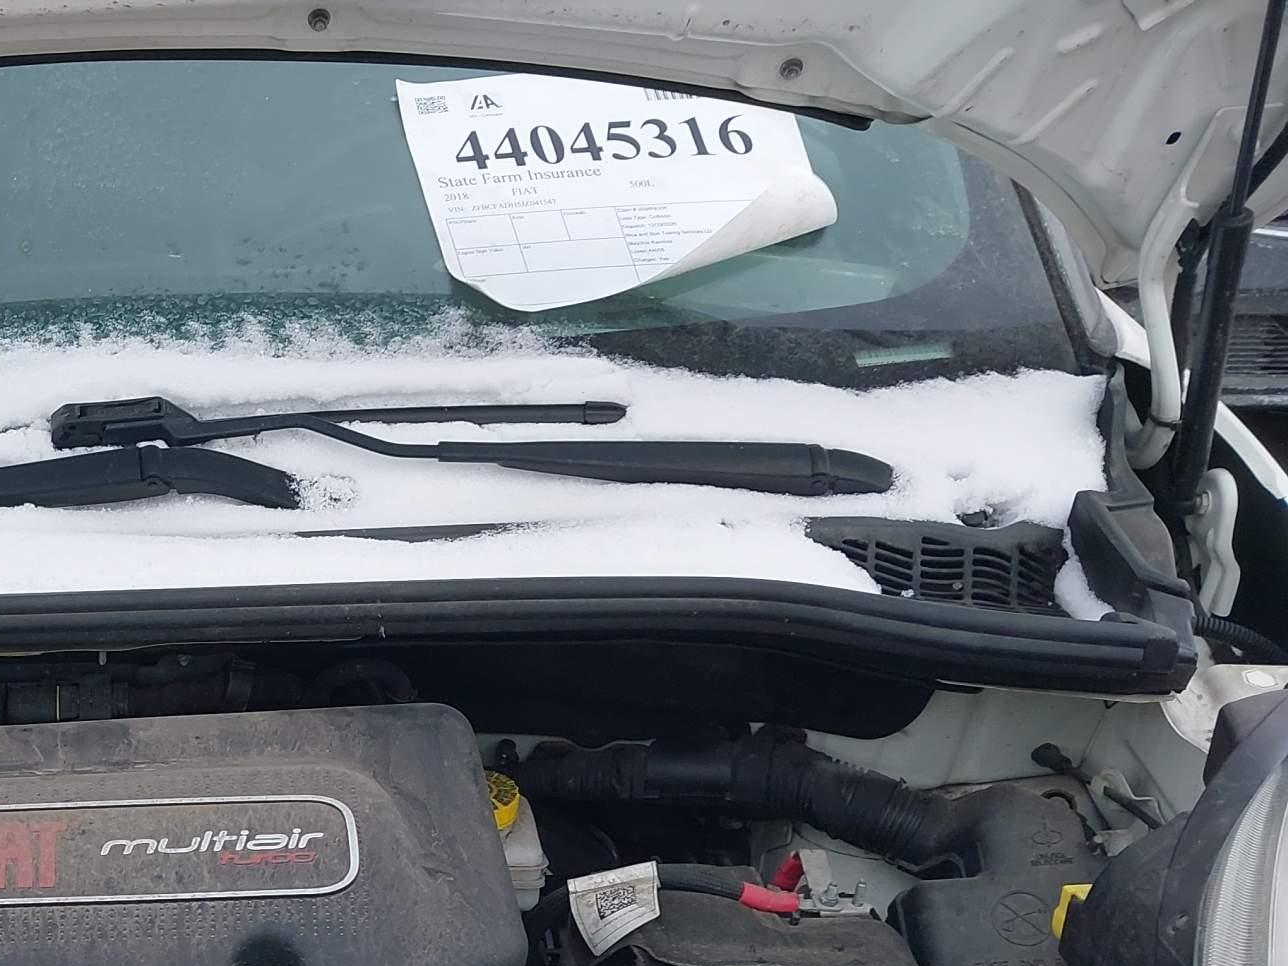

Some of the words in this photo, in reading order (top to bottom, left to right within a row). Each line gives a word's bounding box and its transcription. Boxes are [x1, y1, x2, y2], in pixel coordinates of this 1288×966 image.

[455, 114, 753, 170] 44045316
[438, 175, 478, 189] State
[482, 172, 523, 185] Farm
[527, 166, 602, 181] Insurance
[444, 192, 470, 202] 2018
[511, 186, 538, 196] FIAT
[100, 828, 324, 857] multiair
